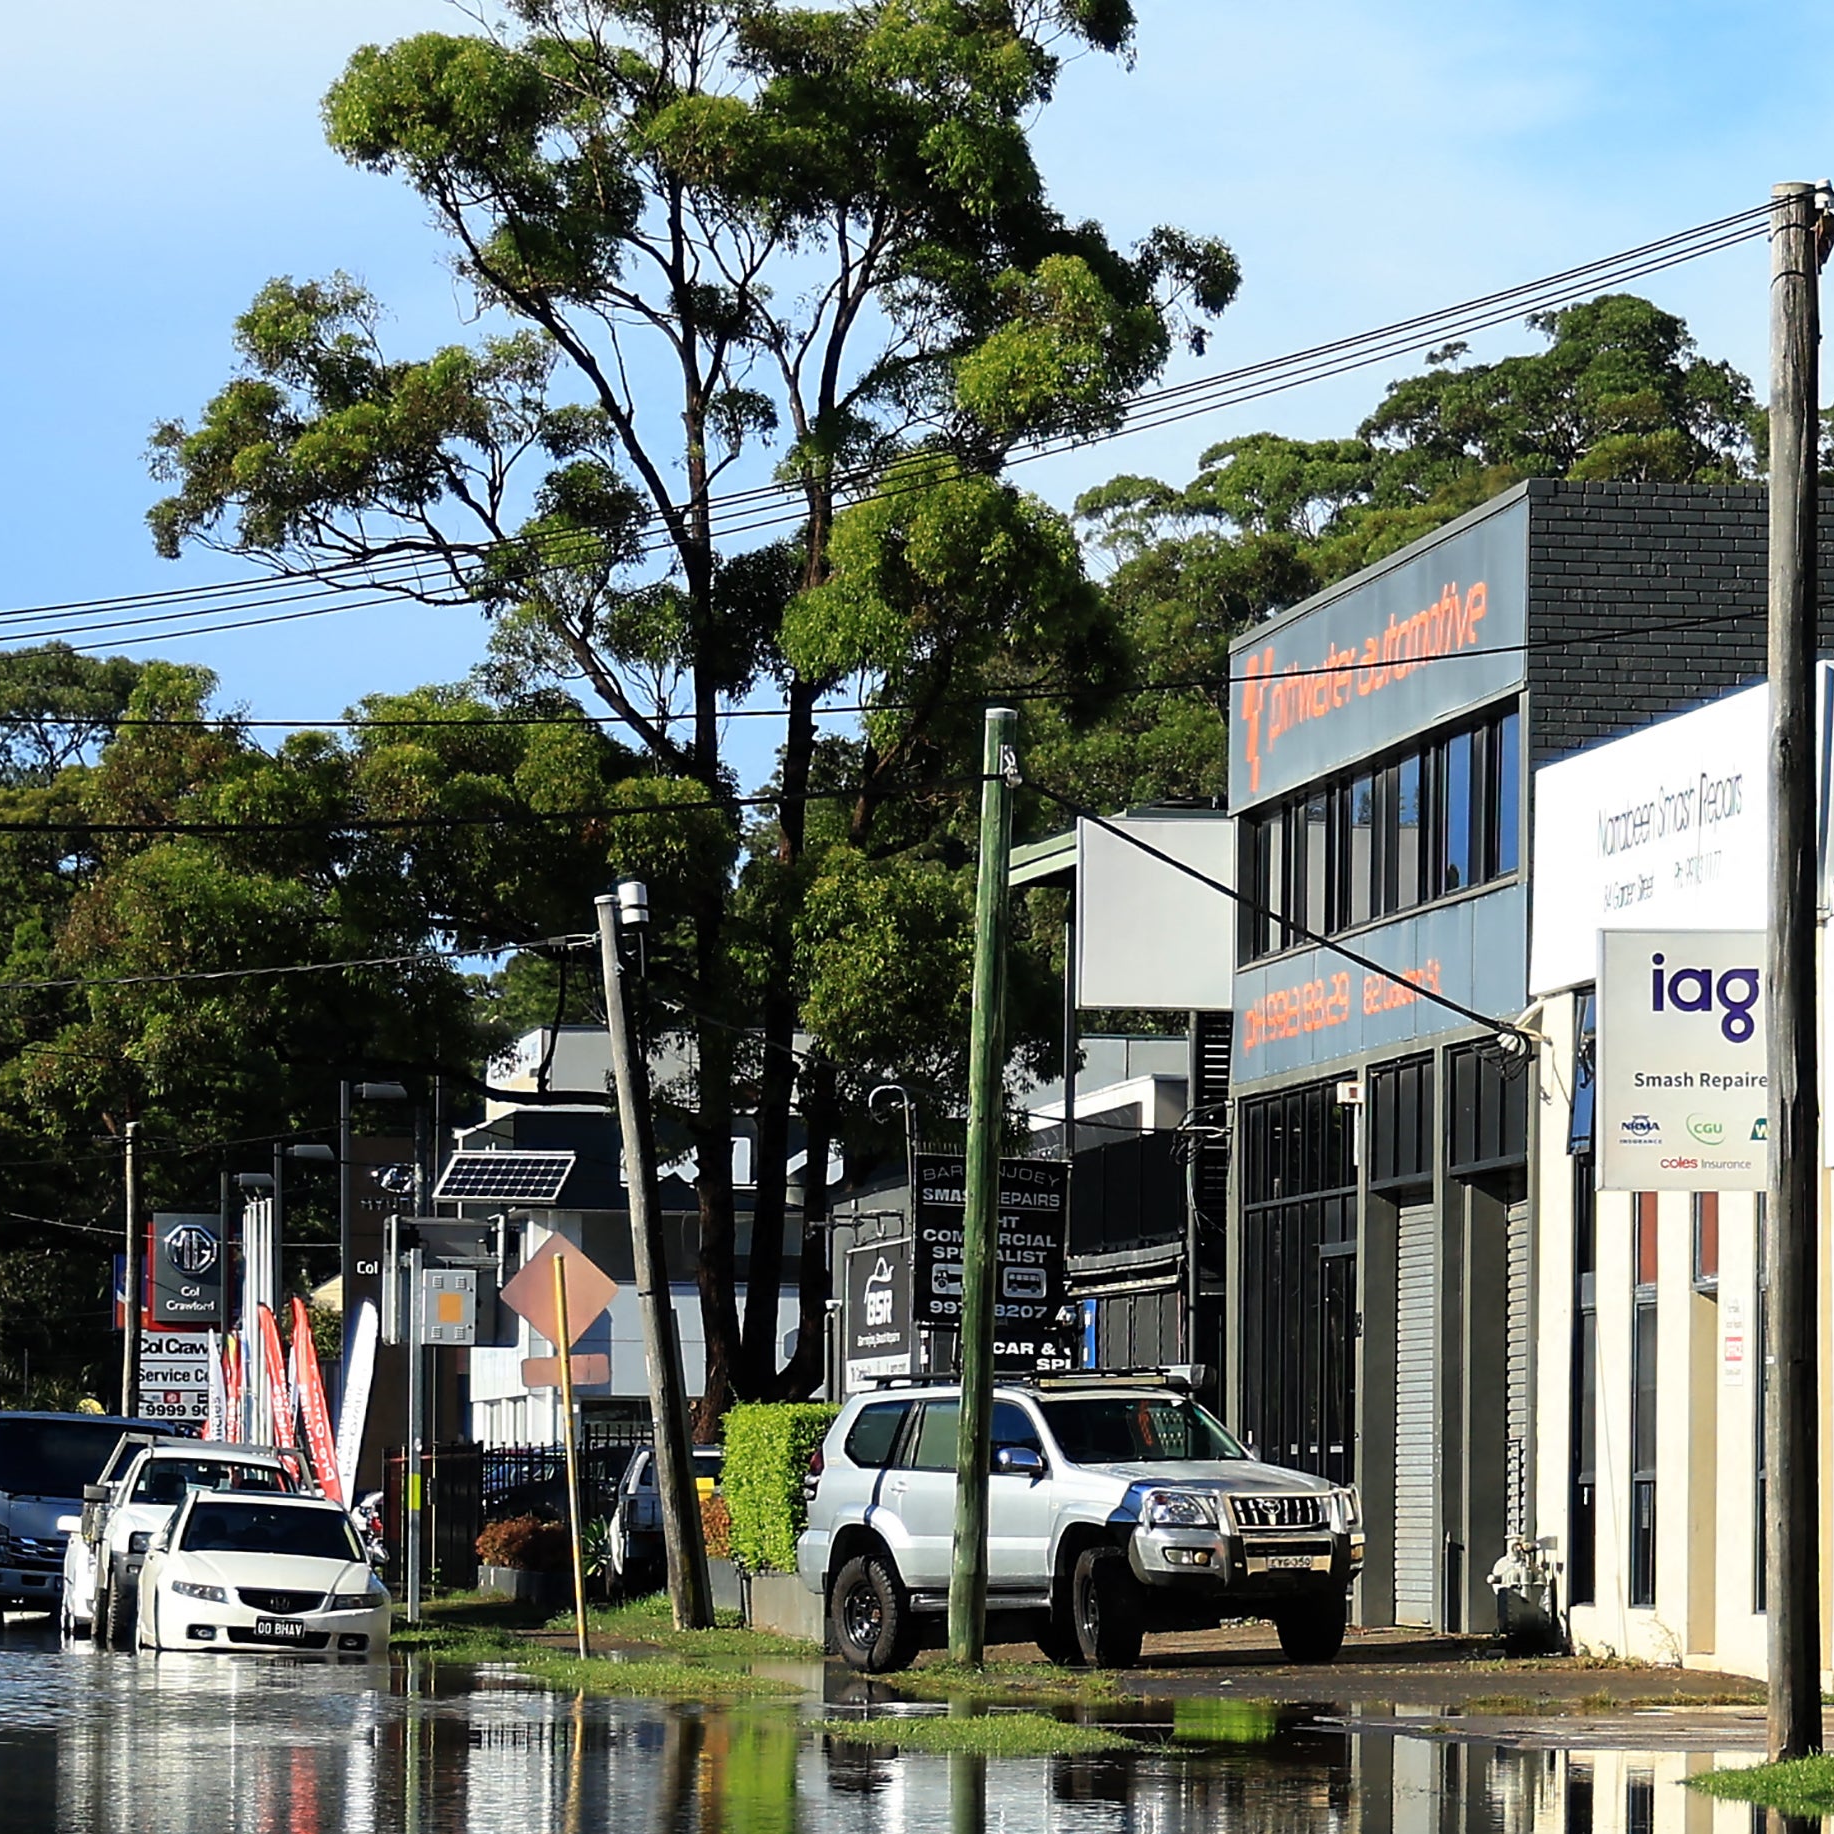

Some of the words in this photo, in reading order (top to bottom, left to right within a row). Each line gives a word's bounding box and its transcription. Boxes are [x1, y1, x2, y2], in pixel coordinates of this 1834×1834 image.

[1357, 581, 1487, 696] automotive
[1651, 952, 1760, 1043] iag
[1634, 1073, 1695, 1088] Smash
[1699, 1072, 1767, 1091] Repaire
[1621, 1120, 1661, 1132] NRMA
[1693, 1122, 1723, 1135] CGU
[1755, 1126, 1767, 1140] W
[1660, 1156, 1699, 1169] coles
[1701, 1158, 1752, 1170] Insurance
[998, 1191, 1061, 1208] EPAIRS
[356, 1260, 379, 1275] Col
[180, 1285, 200, 1297] Col
[165, 1299, 215, 1312] Crawford
[165, 1337, 209, 1355] Craw
[993, 1342, 1034, 1355] CAR
[1041, 1342, 1057, 1356] &
[139, 1367, 191, 1383] Service
[145, 1404, 187, 1417] 9999
[274, 1622, 303, 1637] BHAV
